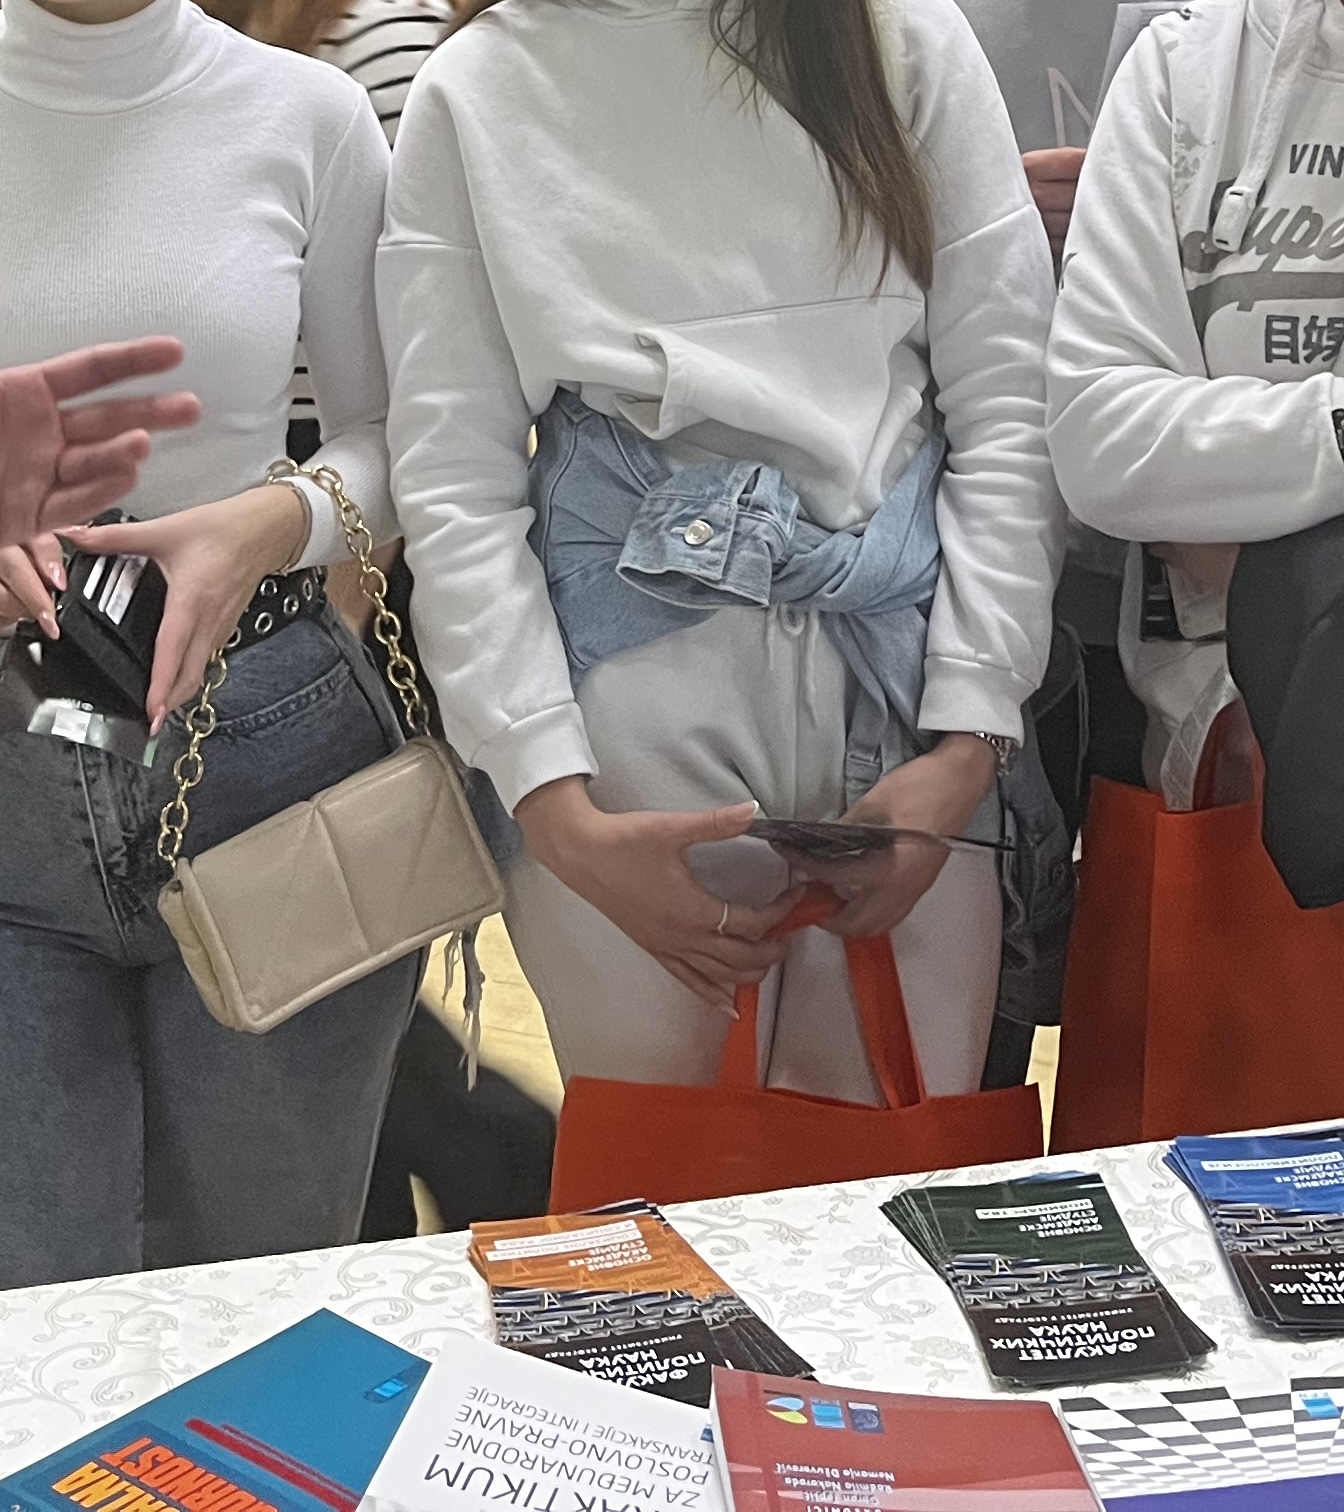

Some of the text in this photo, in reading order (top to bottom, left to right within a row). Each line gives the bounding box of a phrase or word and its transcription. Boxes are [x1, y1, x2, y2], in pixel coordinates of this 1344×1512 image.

[989, 1326, 1155, 1349] ПОЛИТИЧКИХ
[1028, 1320, 1107, 1336] НАУКА
[579, 1349, 657, 1368] НАУКА
[1018, 1341, 1137, 1361] ФАКУЛТЕТ
[582, 1352, 706, 1378] ПОЛИТИЧ
[610, 1369, 688, 1387] ФАКУ
[465, 1386, 579, 1430] INTEGRACIJE
[455, 1404, 709, 1485] POSLOVNO-PRAVNE
[592, 1425, 713, 1465] TRANSAKCIJE
[443, 1429, 700, 1508] ZA MEĐUNARODNE
[842, 1468, 895, 1481] Nemanja
